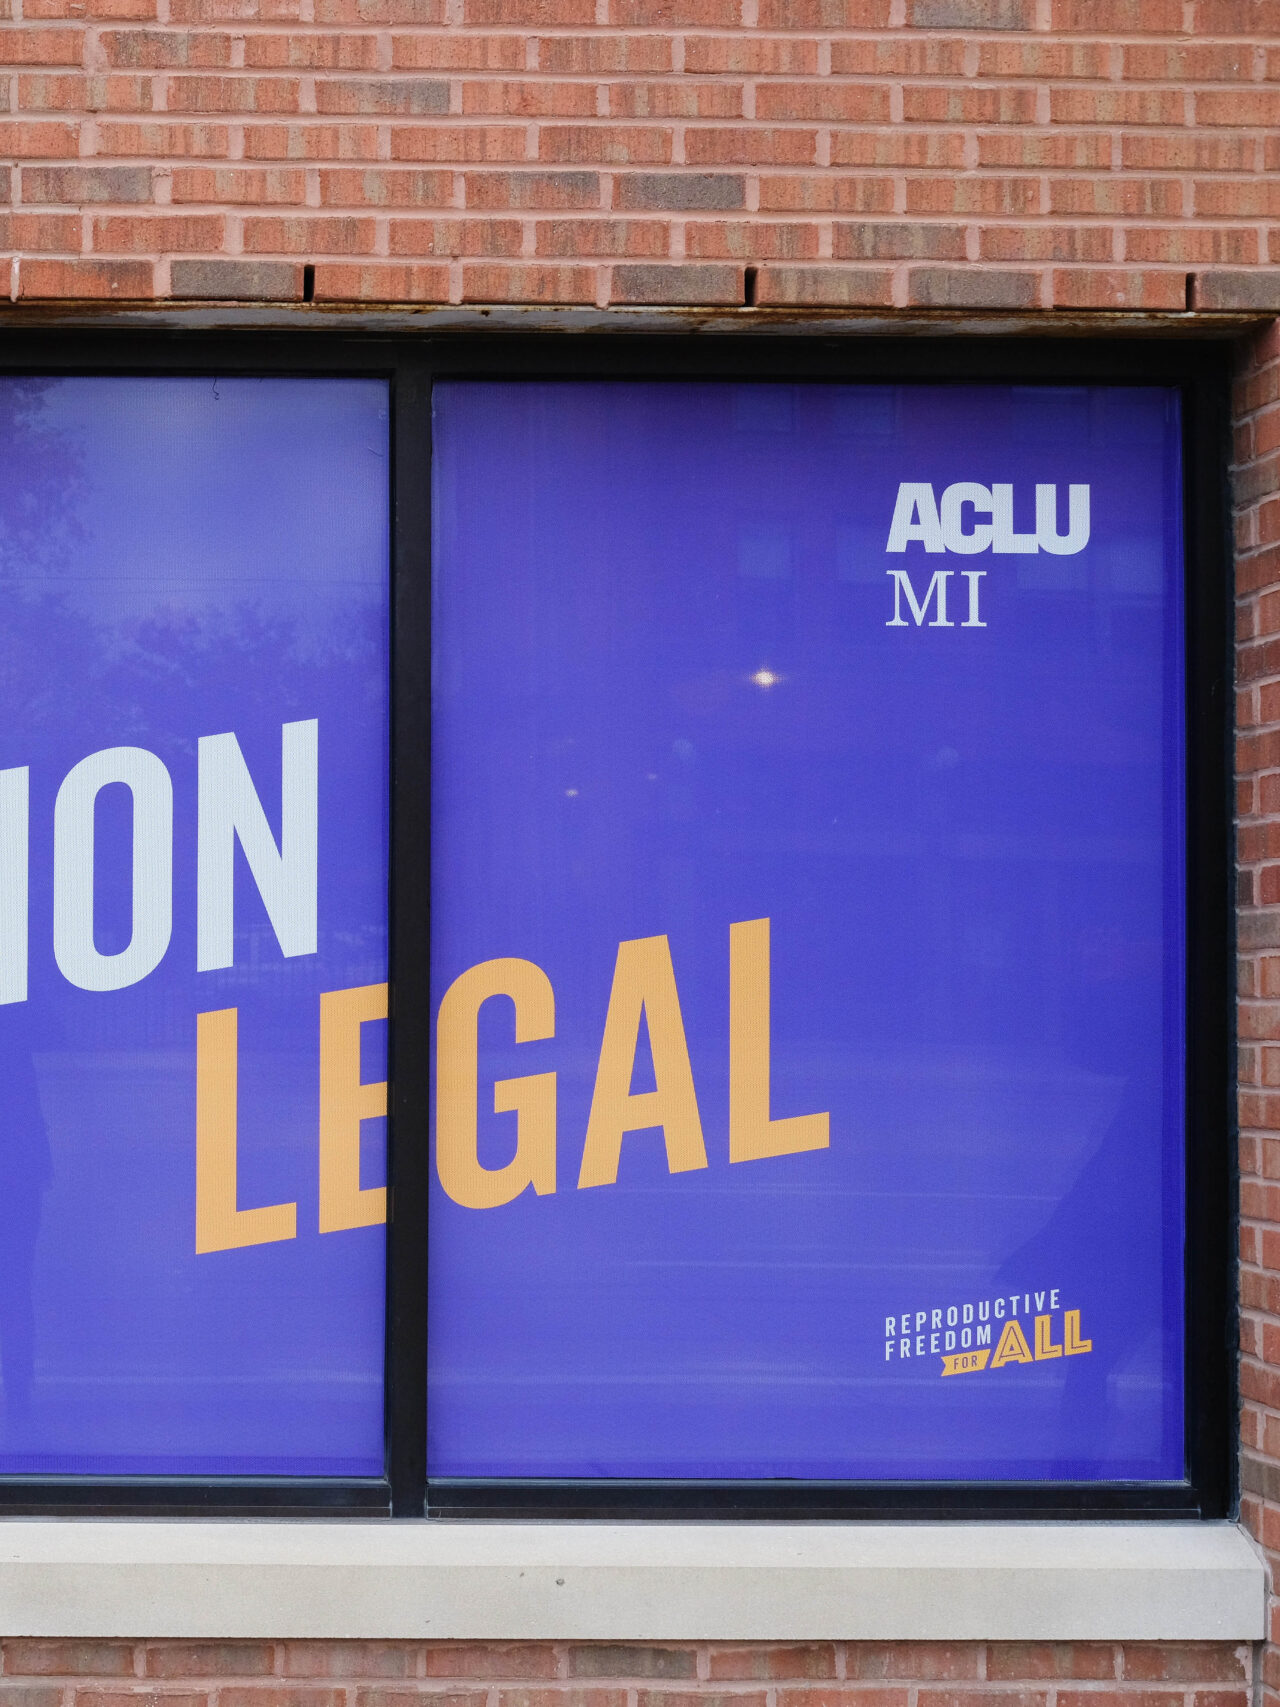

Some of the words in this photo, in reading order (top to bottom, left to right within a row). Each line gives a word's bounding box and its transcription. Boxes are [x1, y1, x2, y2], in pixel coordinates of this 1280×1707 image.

[885, 482, 1091, 556] ACLU
[885, 570, 988, 627] MI
[195, 917, 830, 1255] LEGAL
[885, 1288, 1061, 1338] REPRODUCTIVE
[885, 1323, 992, 1361] FREEDOM
[953, 1354, 978, 1371] FOR
[989, 1309, 1093, 1369] ALL
